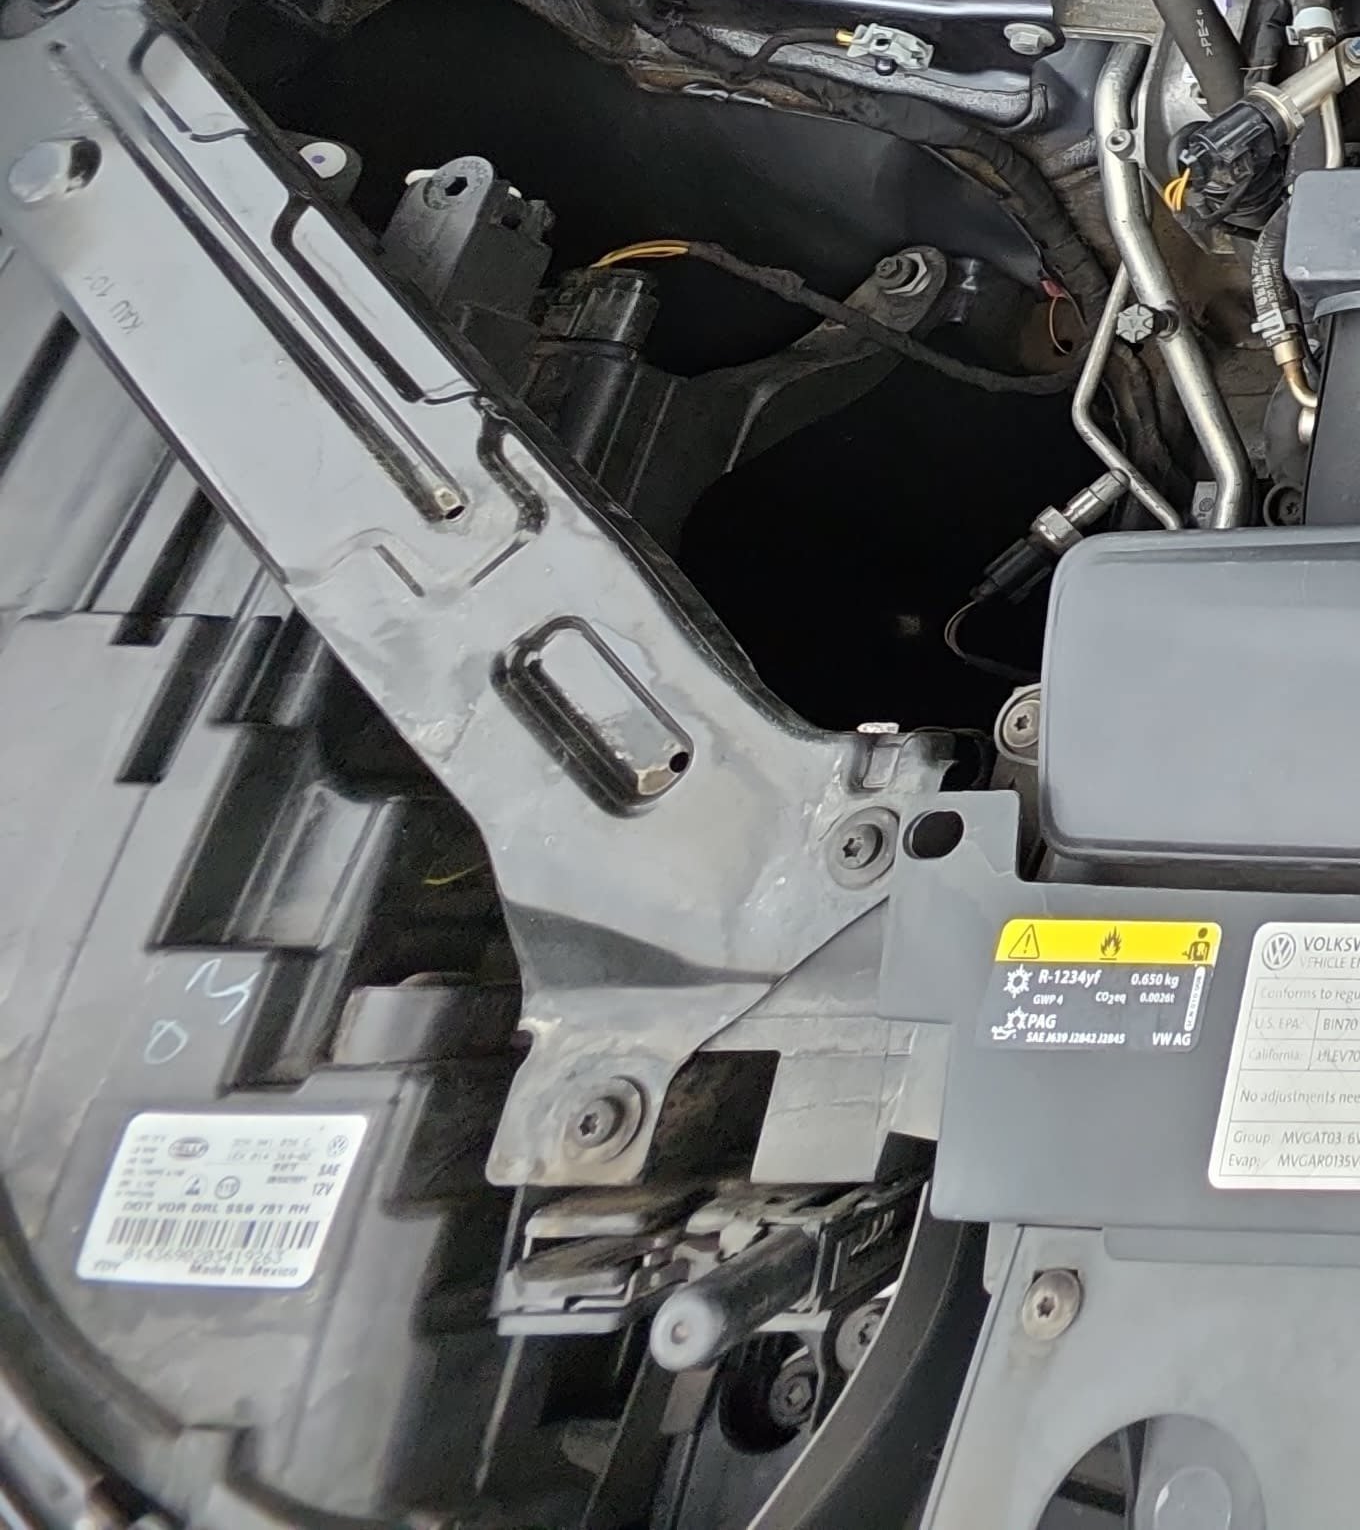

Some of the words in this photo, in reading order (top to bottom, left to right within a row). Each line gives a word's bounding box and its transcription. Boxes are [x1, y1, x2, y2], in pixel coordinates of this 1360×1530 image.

[1299, 956, 1347, 969] VEHICLE
[1037, 969, 1101, 987] R-1234yf
[1129, 973, 1163, 985] 0.650
[1163, 973, 1180, 988] kg
[1259, 986, 1317, 999] Conforms
[1320, 988, 1330, 999] to
[1032, 994, 1056, 1005] GWP
[1056, 995, 1063, 1005] 4
[1026, 1013, 1057, 1029] PAG
[1322, 1017, 1358, 1030] BIN70
[1025, 1031, 1046, 1042] SAE
[1150, 1032, 1174, 1045] VW
[1173, 1032, 1192, 1045] AG
[1239, 1090, 1258, 1102] No
[1259, 1090, 1336, 1105] adjustments
[310, 1181, 335, 1196] 12V
[247, 1265, 300, 1278] Mexico
